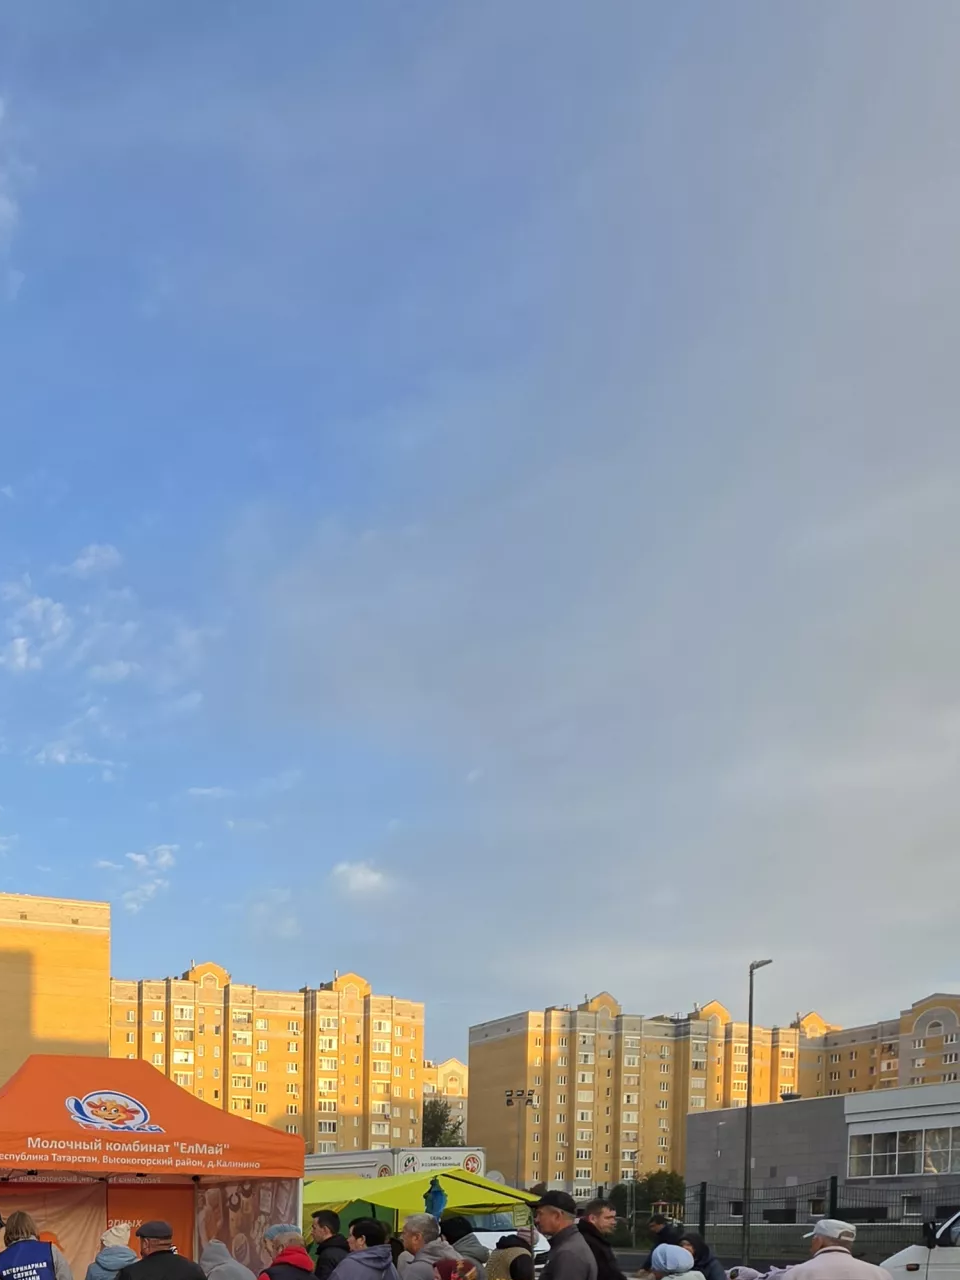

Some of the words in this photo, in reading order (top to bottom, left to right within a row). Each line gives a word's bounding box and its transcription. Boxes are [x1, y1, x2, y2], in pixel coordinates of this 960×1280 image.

[27, 1137, 102, 1150] Молочный
[106, 1141, 170, 1153] комбинат
[173, 1142, 230, 1155] "ЕлМай"
[52, 1153, 100, 1164] Татарстан,
[102, 1156, 173, 1167] Высокогорский
[175, 1158, 205, 1168] район,
[207, 1159, 260, 1169] д.Калинино
